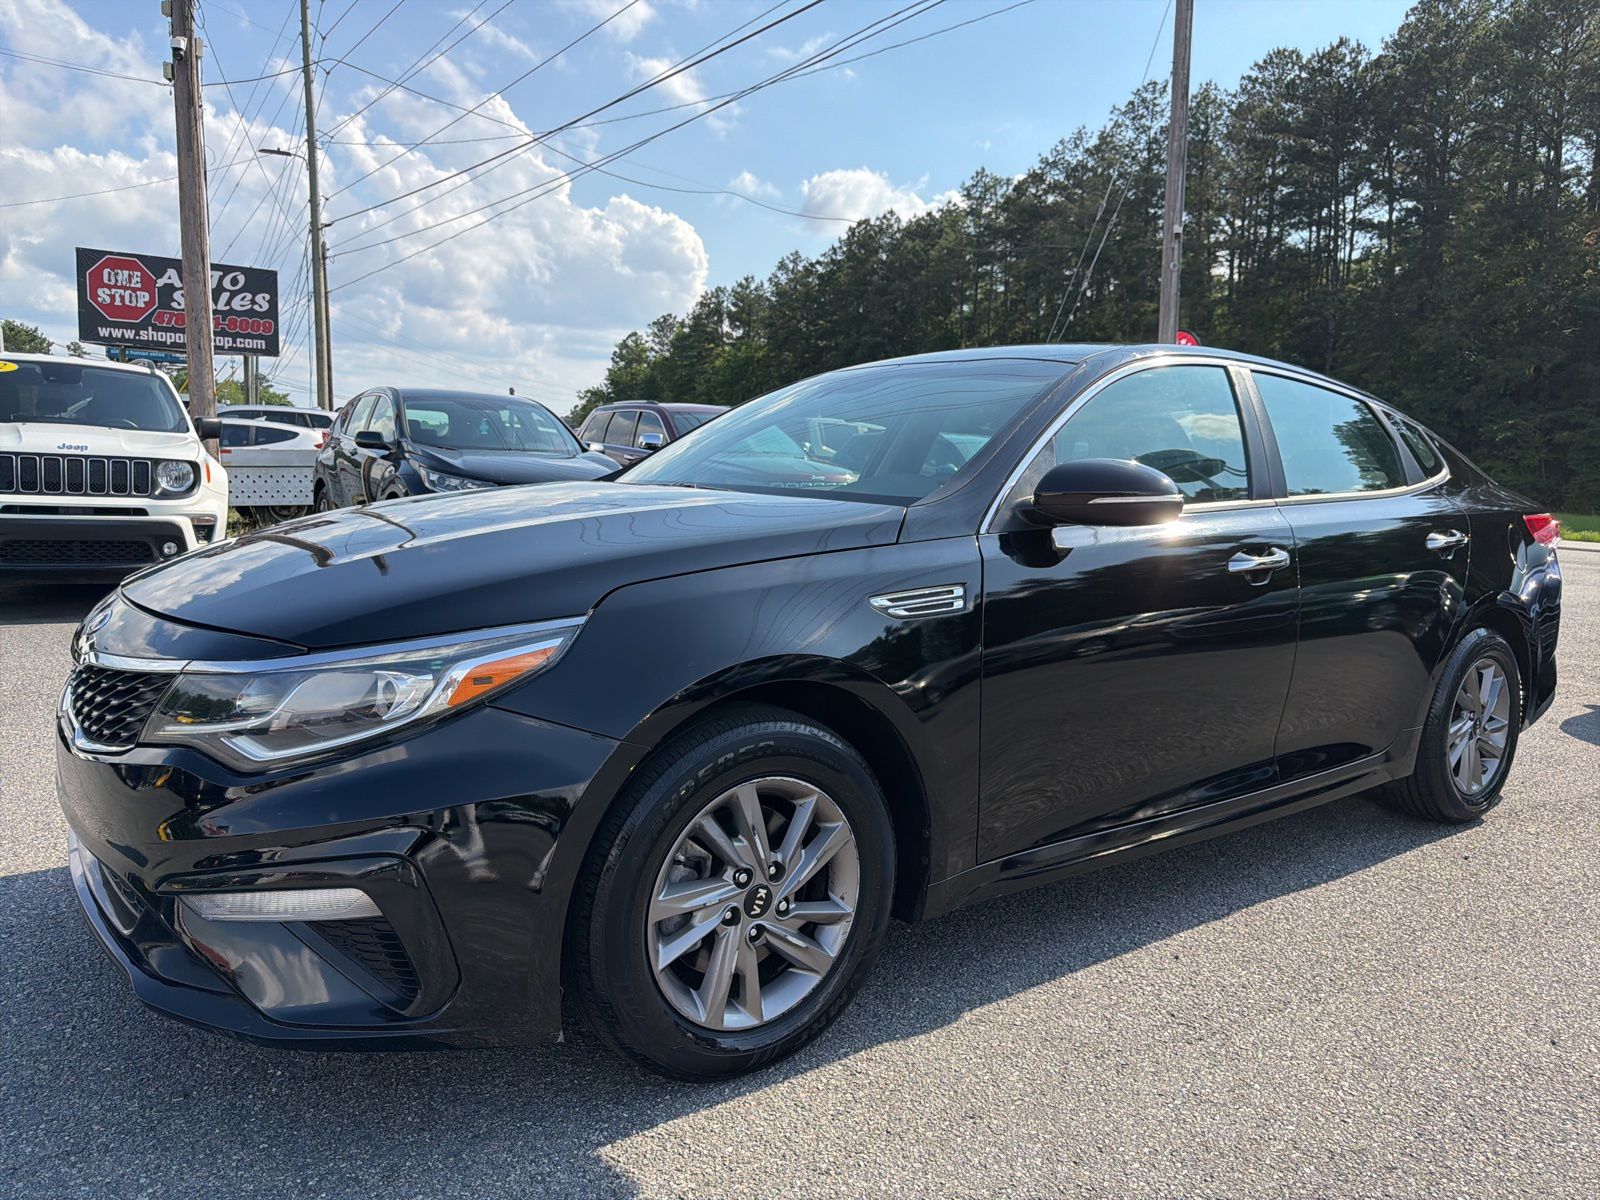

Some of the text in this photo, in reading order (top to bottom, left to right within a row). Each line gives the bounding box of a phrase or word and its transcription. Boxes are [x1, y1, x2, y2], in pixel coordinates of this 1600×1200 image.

[103, 267, 142, 289] ONE
[155, 268, 246, 291] ATO
[97, 287, 149, 308] STOP
[152, 309, 275, 335] 4781-8009
[97, 326, 266, 349] www.shopoop.com
[56, 442, 89, 453] Jeep
[750, 888, 768, 915] KIA
